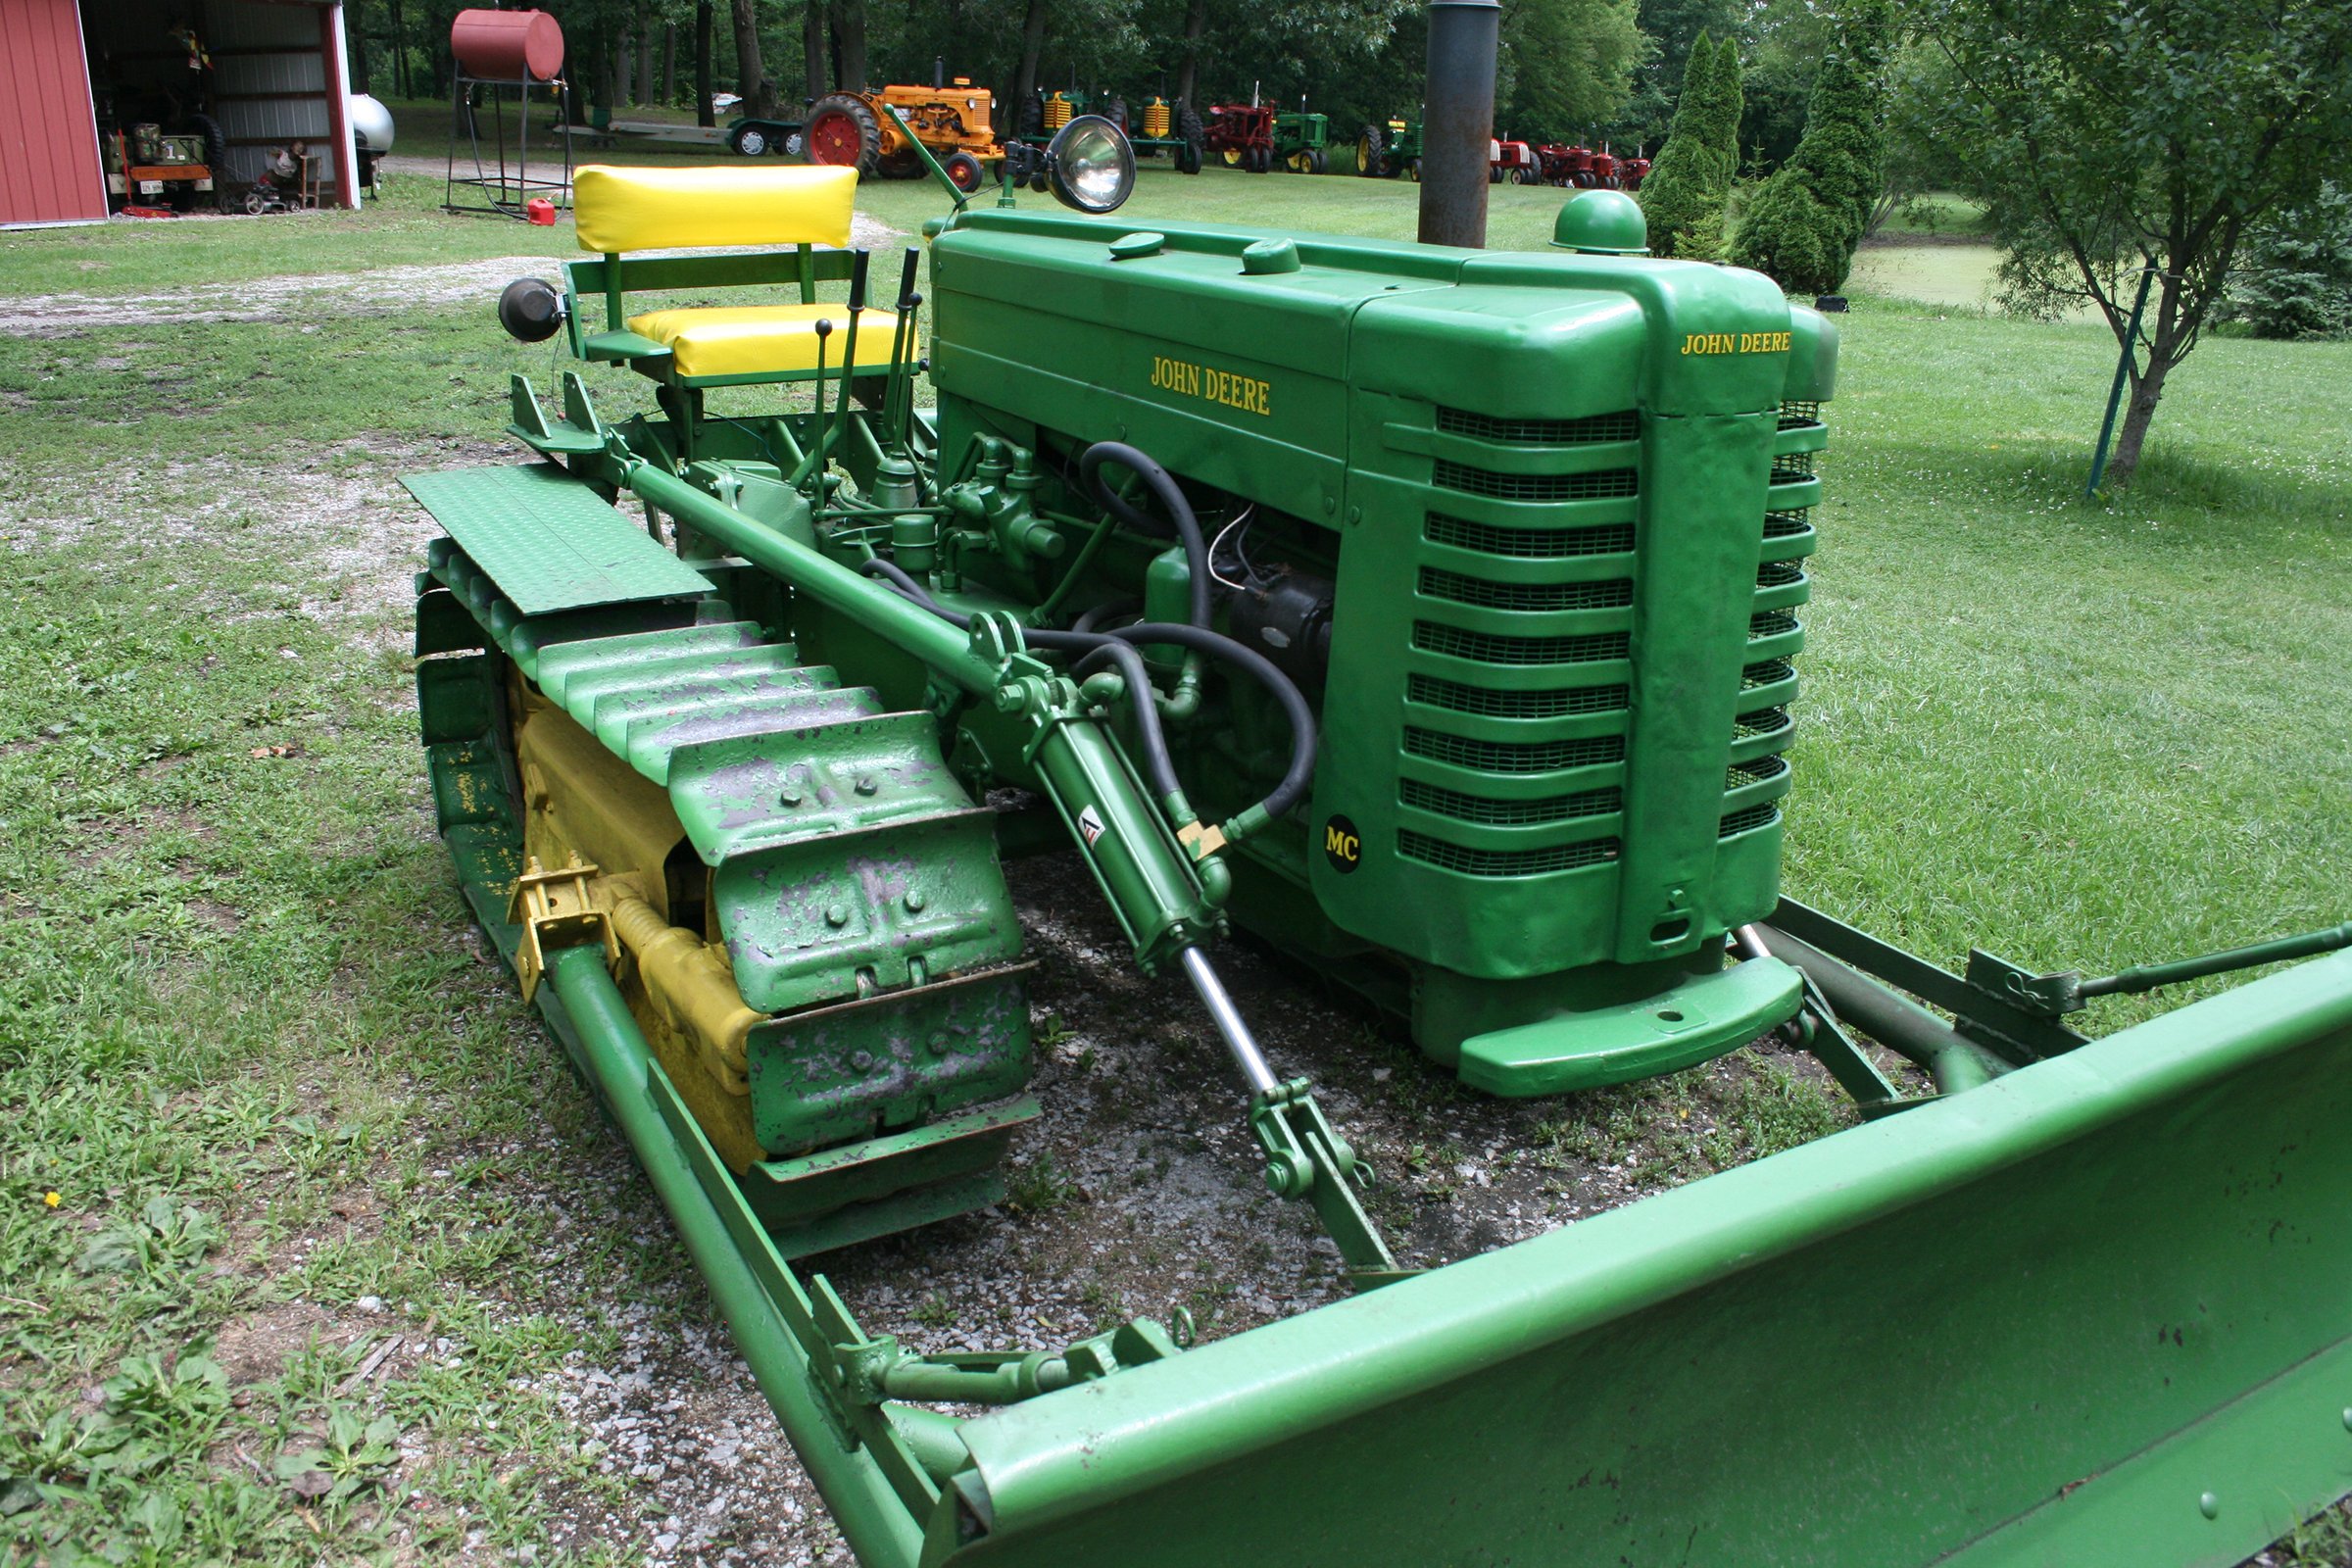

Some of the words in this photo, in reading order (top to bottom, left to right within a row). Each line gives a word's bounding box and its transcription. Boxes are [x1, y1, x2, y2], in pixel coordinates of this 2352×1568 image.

[1681, 333, 1735, 354] JOHN
[1740, 332, 1791, 353] DEERE
[1152, 356, 1200, 396] JOHN
[1205, 368, 1270, 416] DEERE
[1326, 825, 1358, 861] MC
